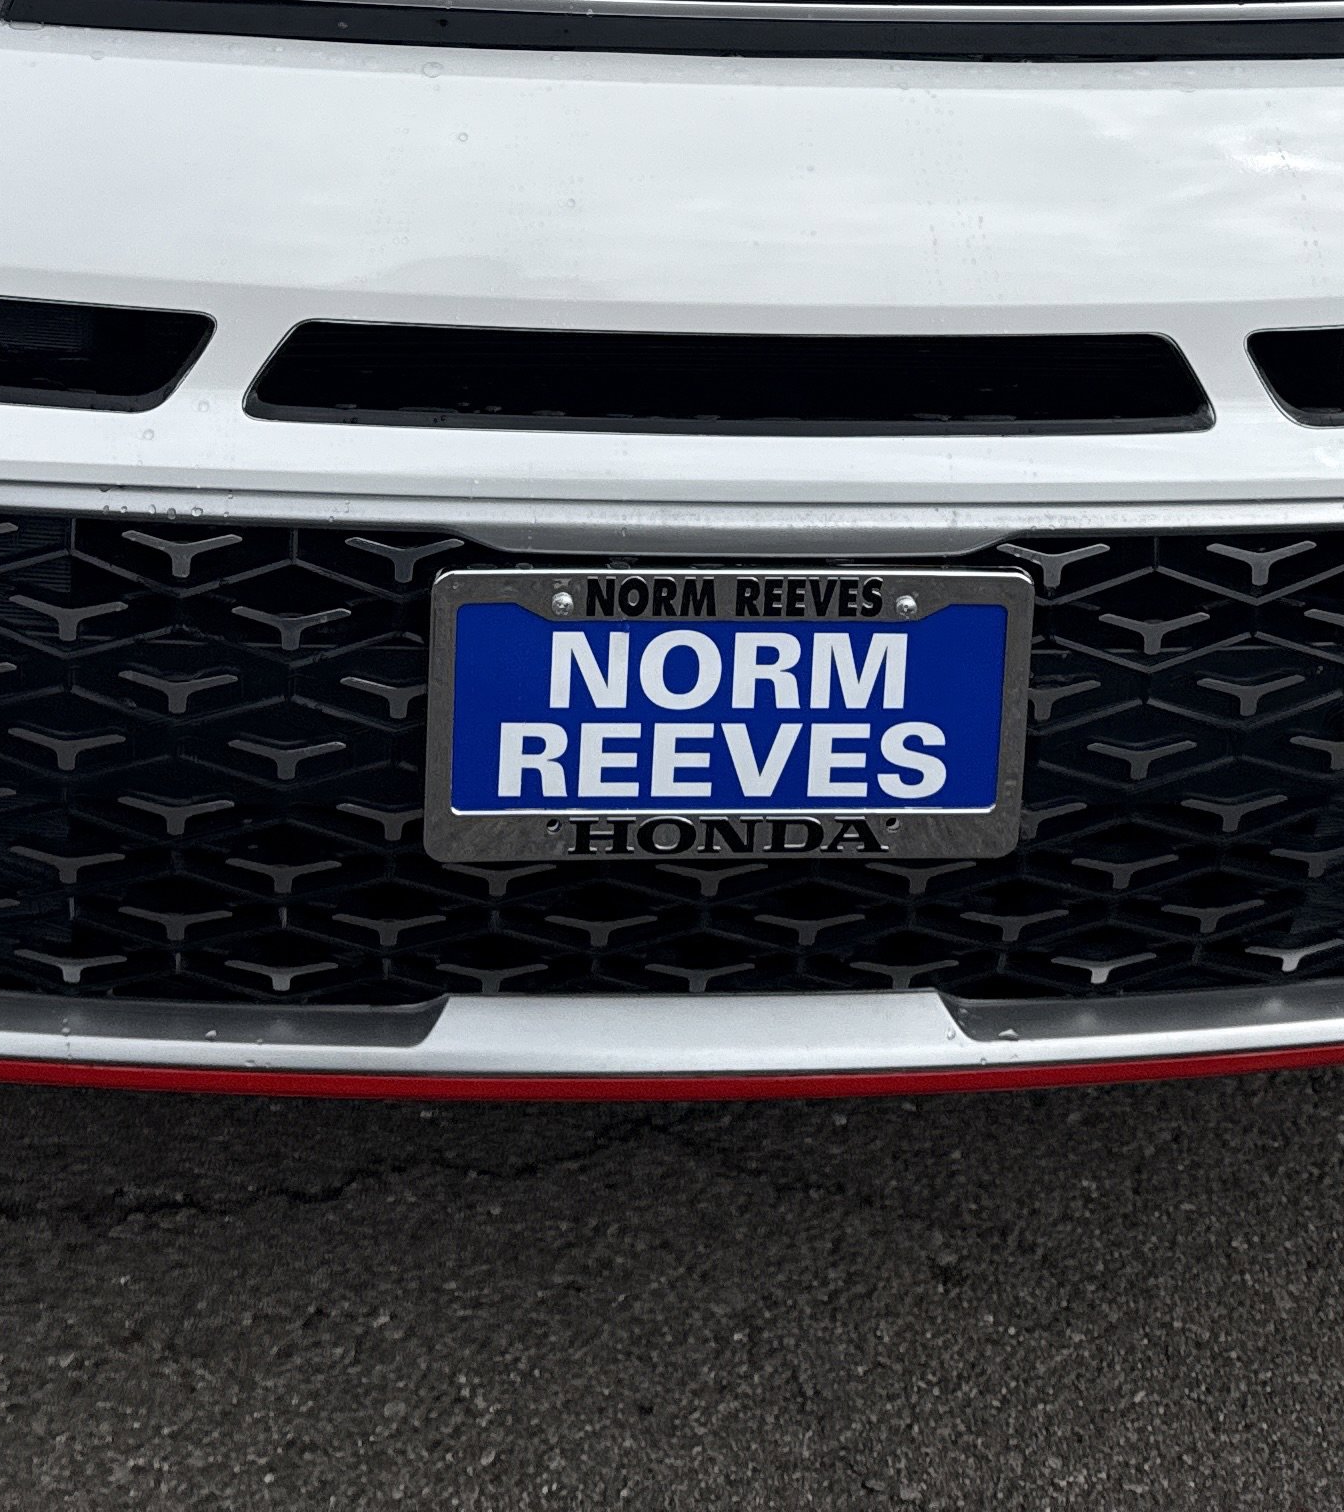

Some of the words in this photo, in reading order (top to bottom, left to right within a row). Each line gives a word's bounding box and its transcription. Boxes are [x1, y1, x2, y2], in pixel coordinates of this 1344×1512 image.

[585, 575, 718, 617] NORM
[734, 576, 884, 618] REEVES
[548, 629, 909, 710] NORM
[497, 720, 948, 801] REEVES
[568, 815, 891, 856] HONDA
